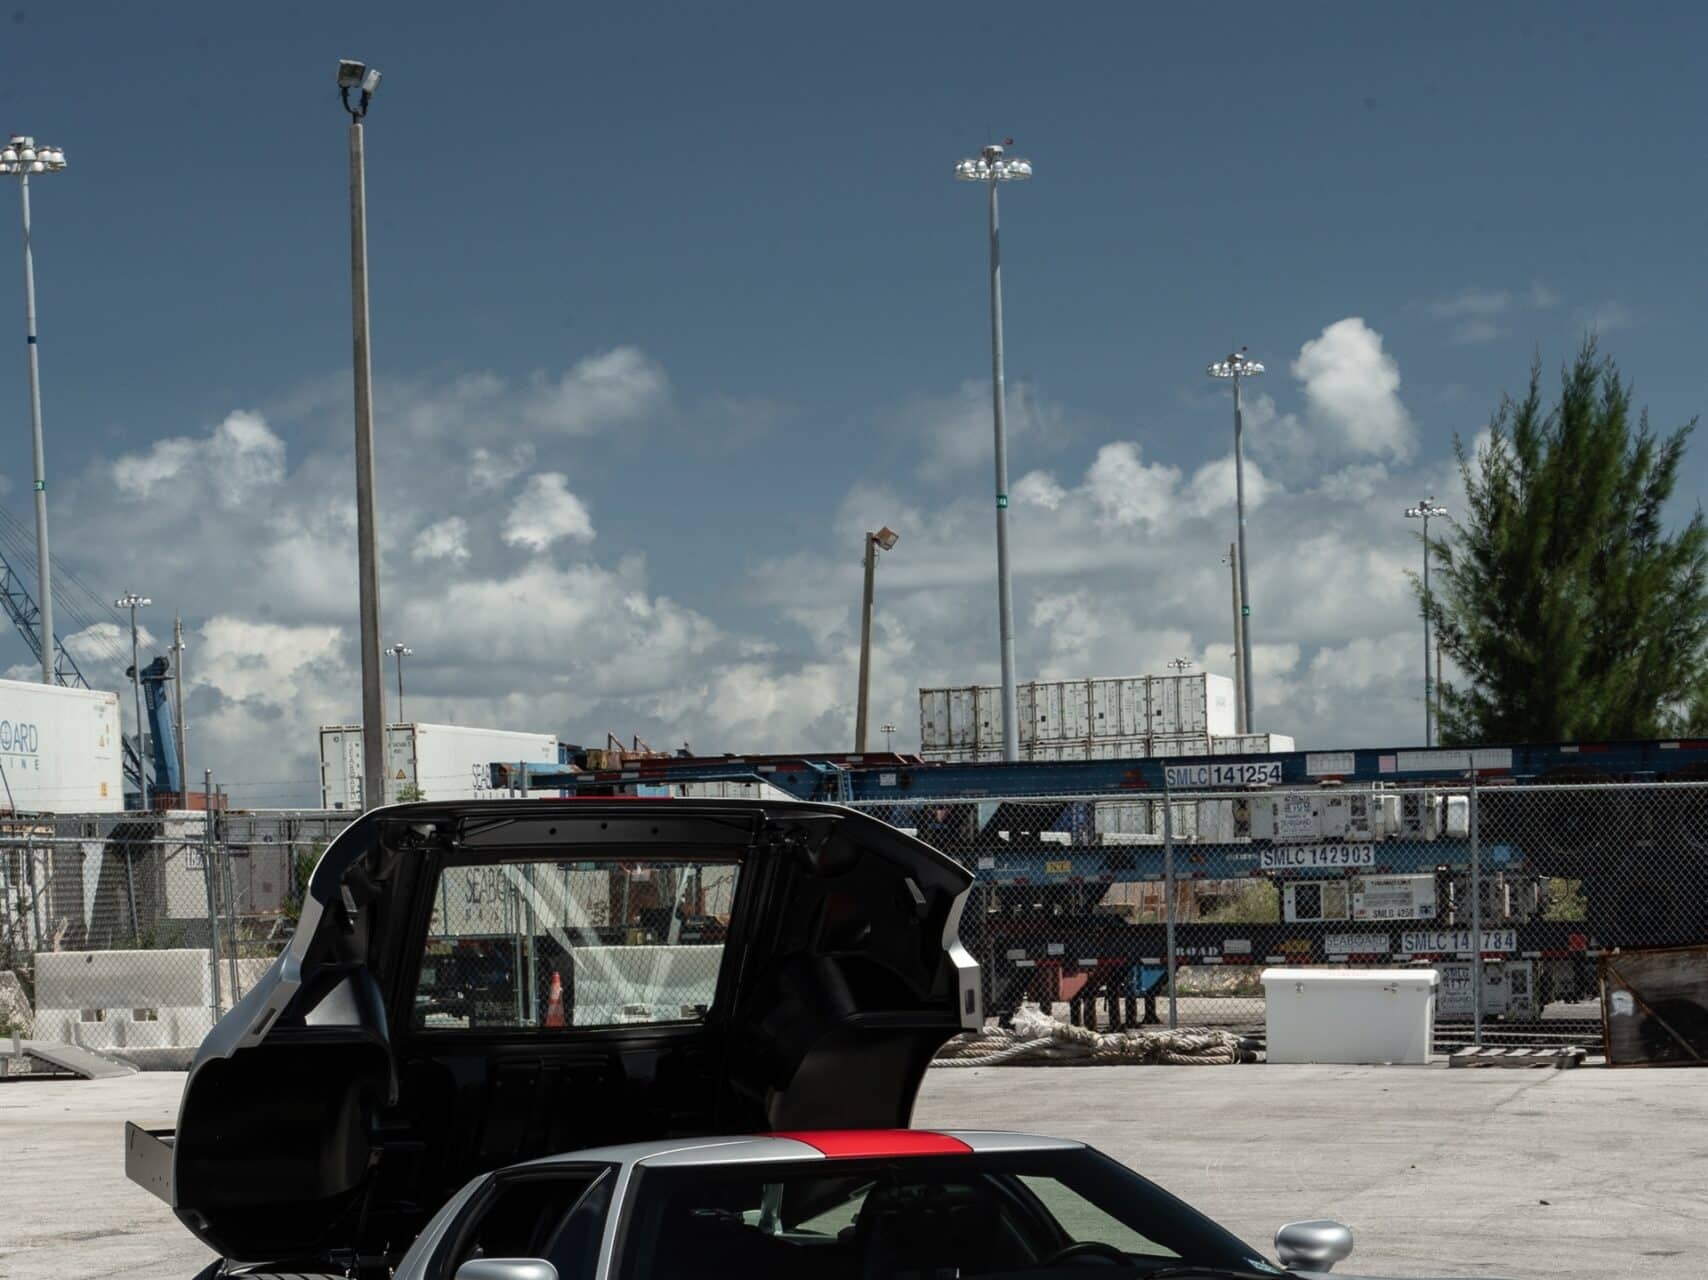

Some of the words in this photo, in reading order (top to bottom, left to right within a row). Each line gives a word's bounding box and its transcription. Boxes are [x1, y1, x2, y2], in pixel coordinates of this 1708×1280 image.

[1167, 767, 1208, 785] SMLC
[1214, 765, 1280, 783] 141254
[1264, 849, 1305, 865] SMLC
[1311, 846, 1371, 864] 142903
[1404, 934, 1447, 950] SMLC
[1451, 932, 1513, 949] 14784
